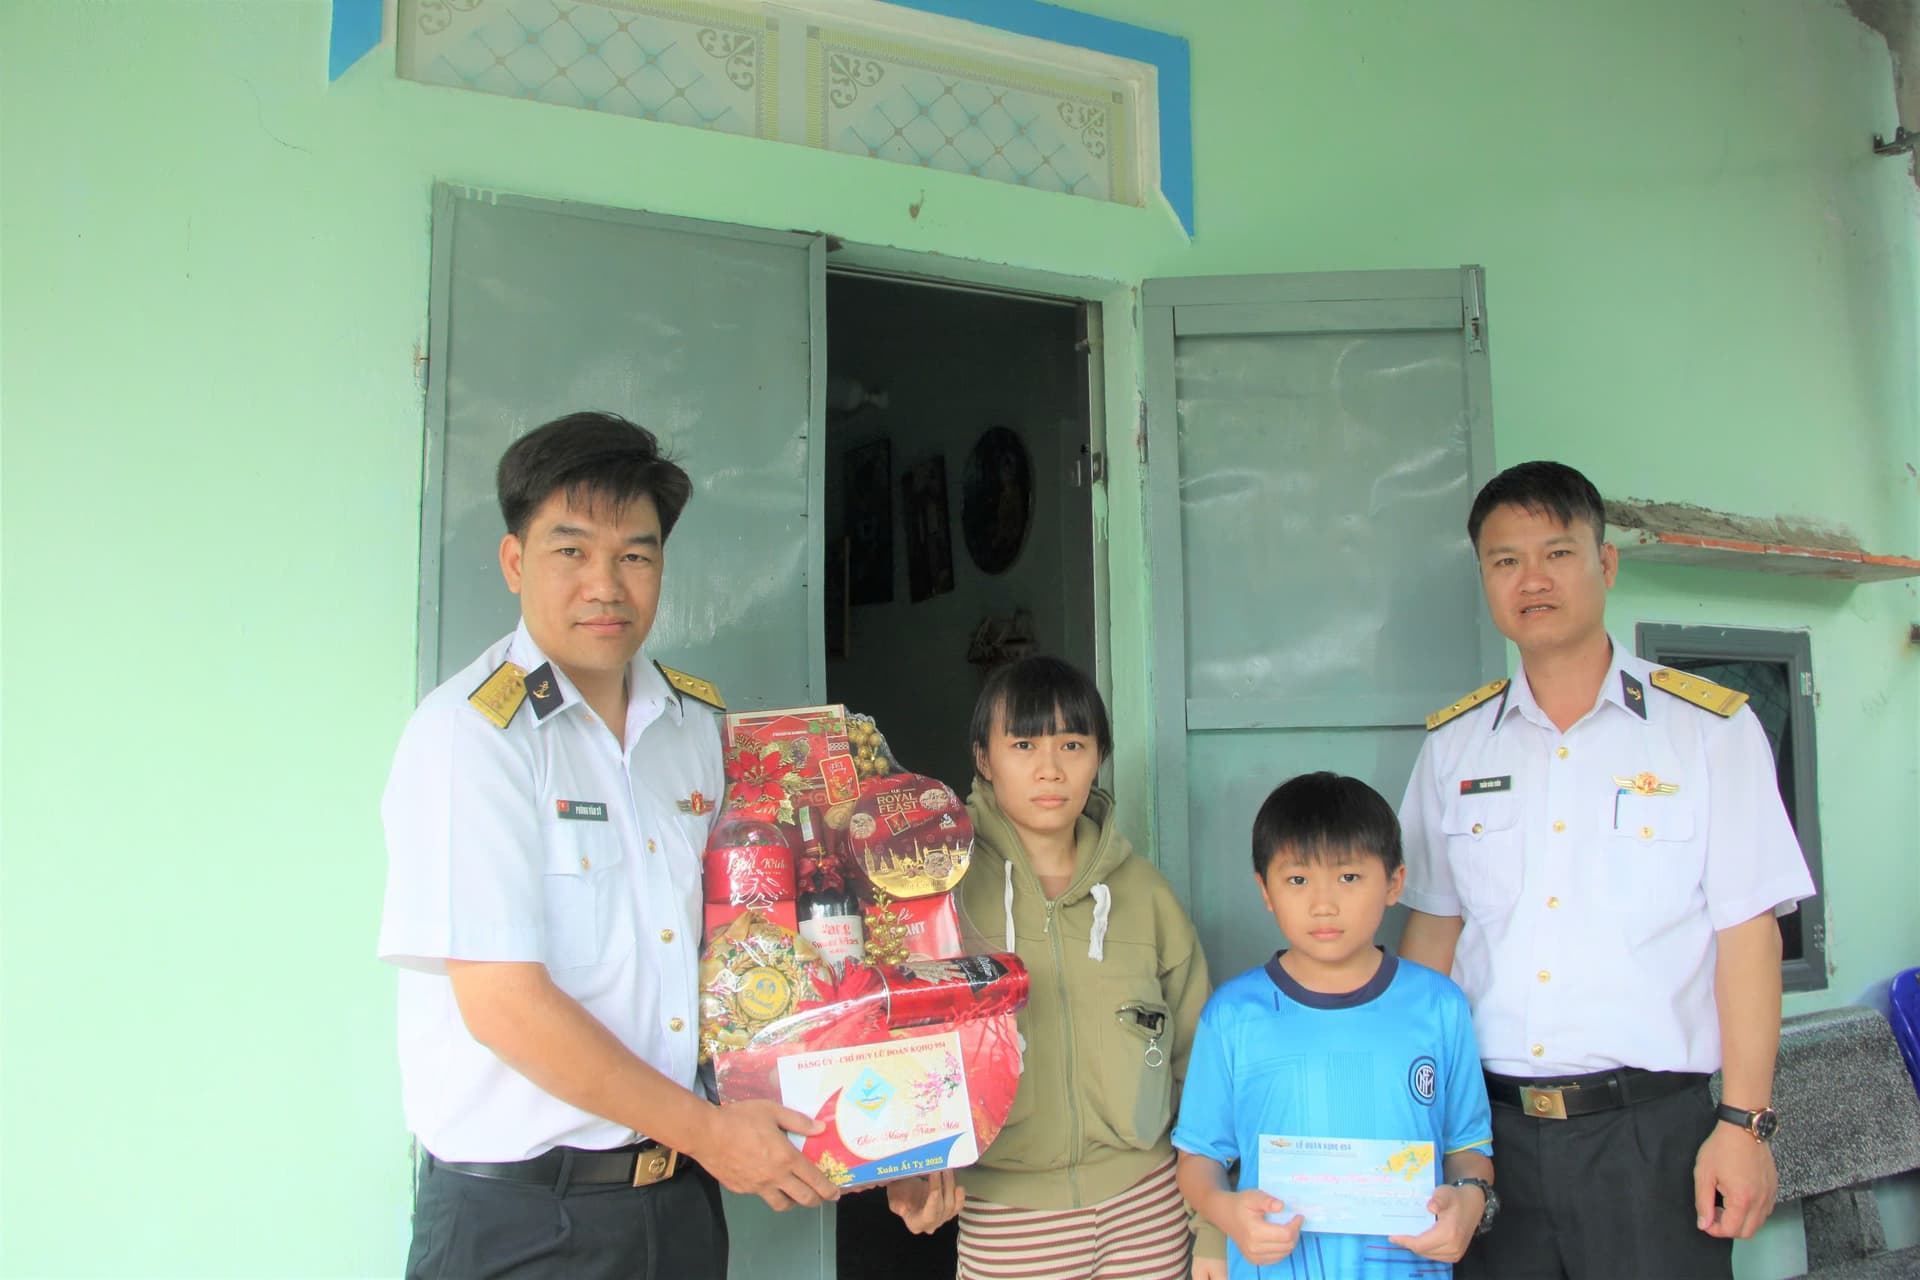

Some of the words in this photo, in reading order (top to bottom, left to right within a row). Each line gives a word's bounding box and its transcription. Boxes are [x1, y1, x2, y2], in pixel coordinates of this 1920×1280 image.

[877, 792, 918, 805] ROYAL
[879, 801, 918, 814] FEAST
[876, 1164, 899, 1175] Xuân
[925, 1157, 943, 1167] 2025
